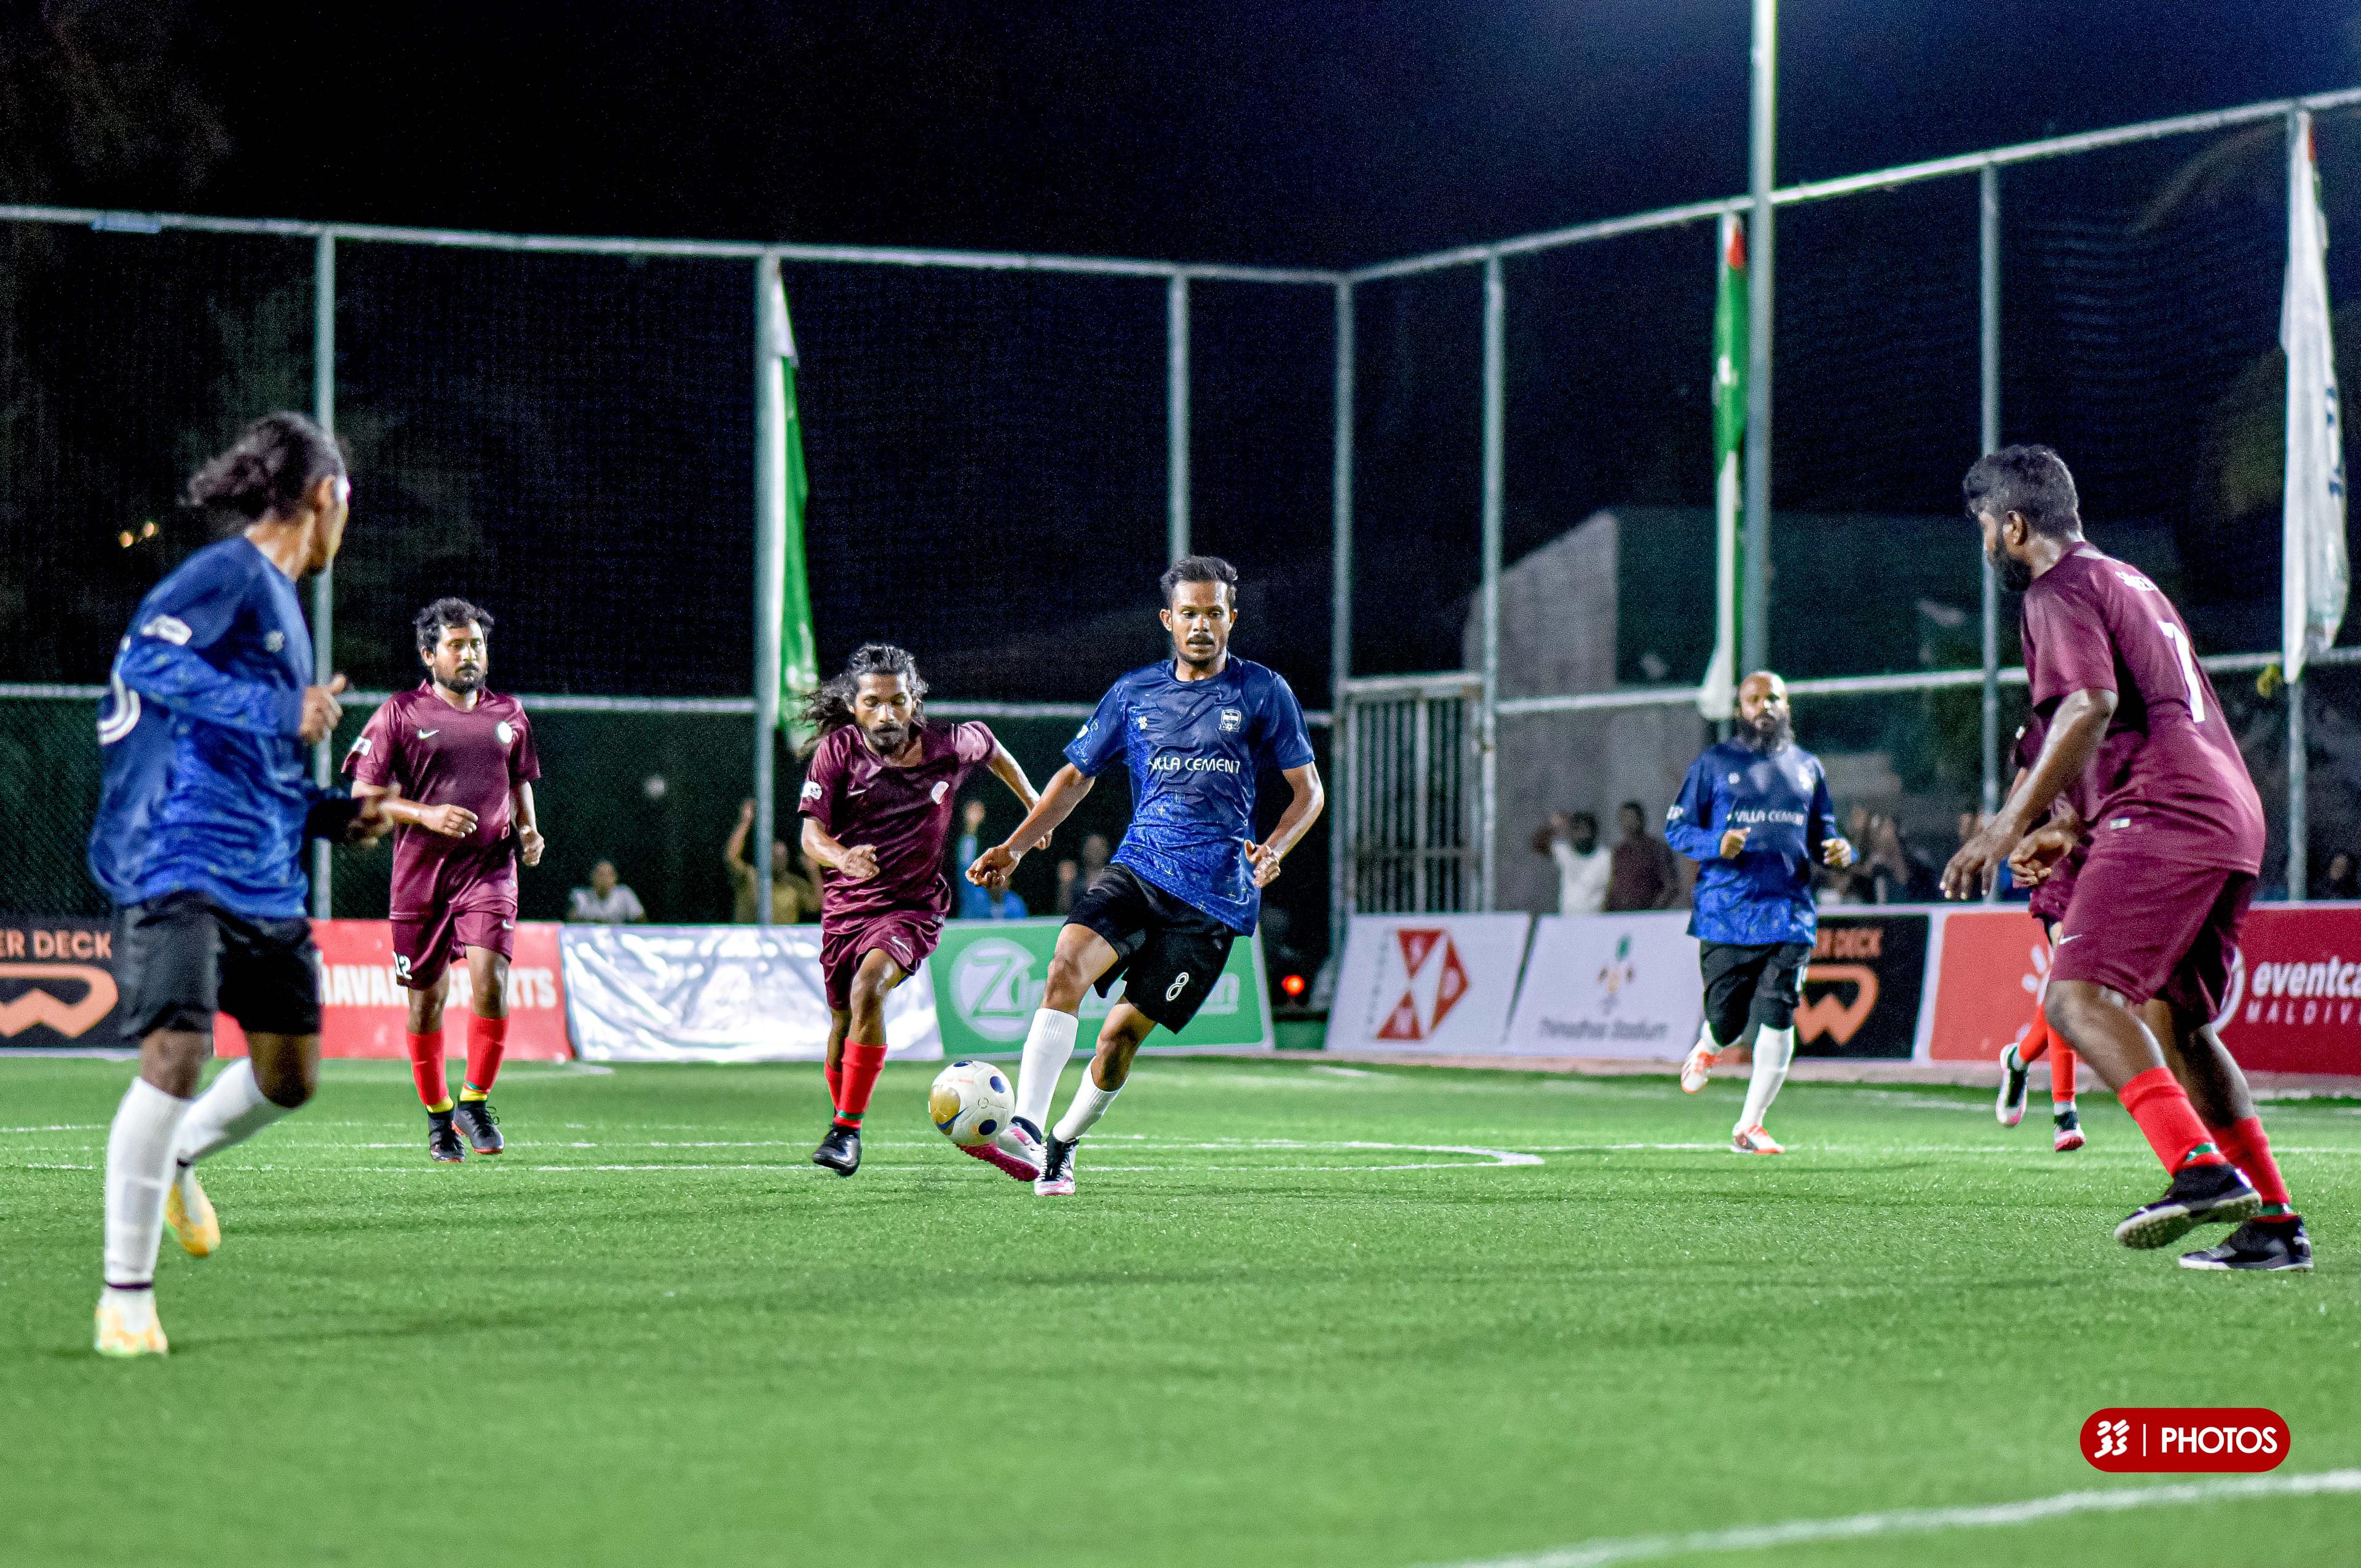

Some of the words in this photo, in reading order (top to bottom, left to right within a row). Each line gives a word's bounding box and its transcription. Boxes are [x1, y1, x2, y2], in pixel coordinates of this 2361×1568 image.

[33, 929, 112, 959] DECK
[1166, 972, 1190, 1002] 8
[2245, 999, 2361, 1026] MALDIV
